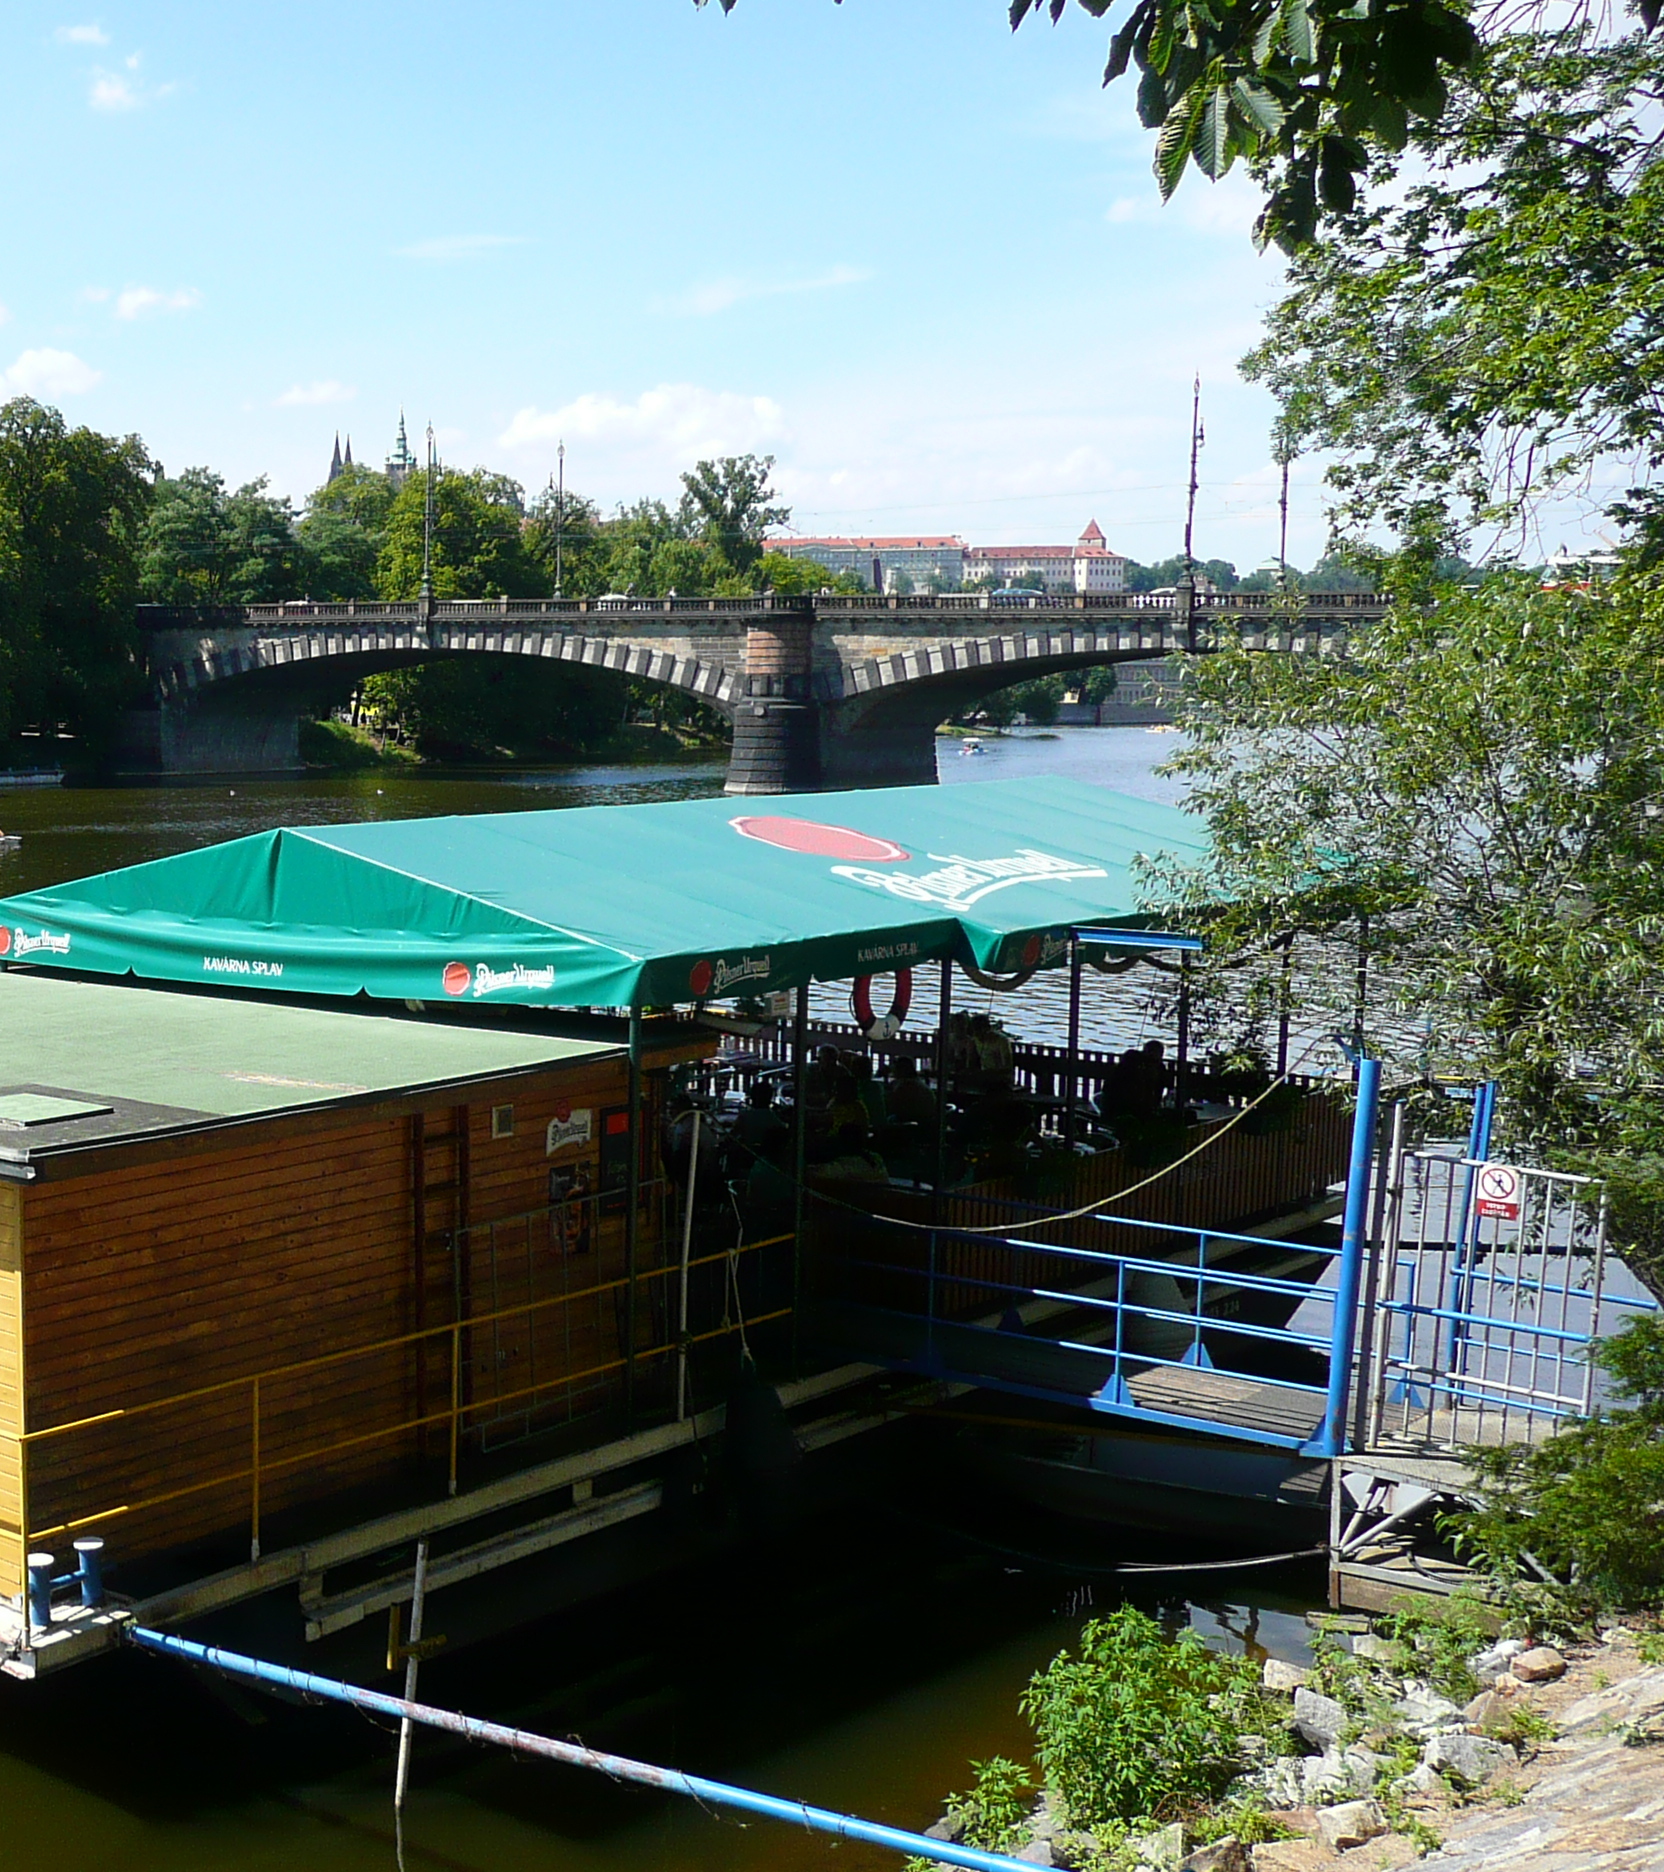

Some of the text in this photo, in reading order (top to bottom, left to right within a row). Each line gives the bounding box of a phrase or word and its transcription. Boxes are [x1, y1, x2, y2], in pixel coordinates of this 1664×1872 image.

[203, 956, 284, 977] KAVÁRNA SPLAV
[473, 962, 516, 998] Pilsner
